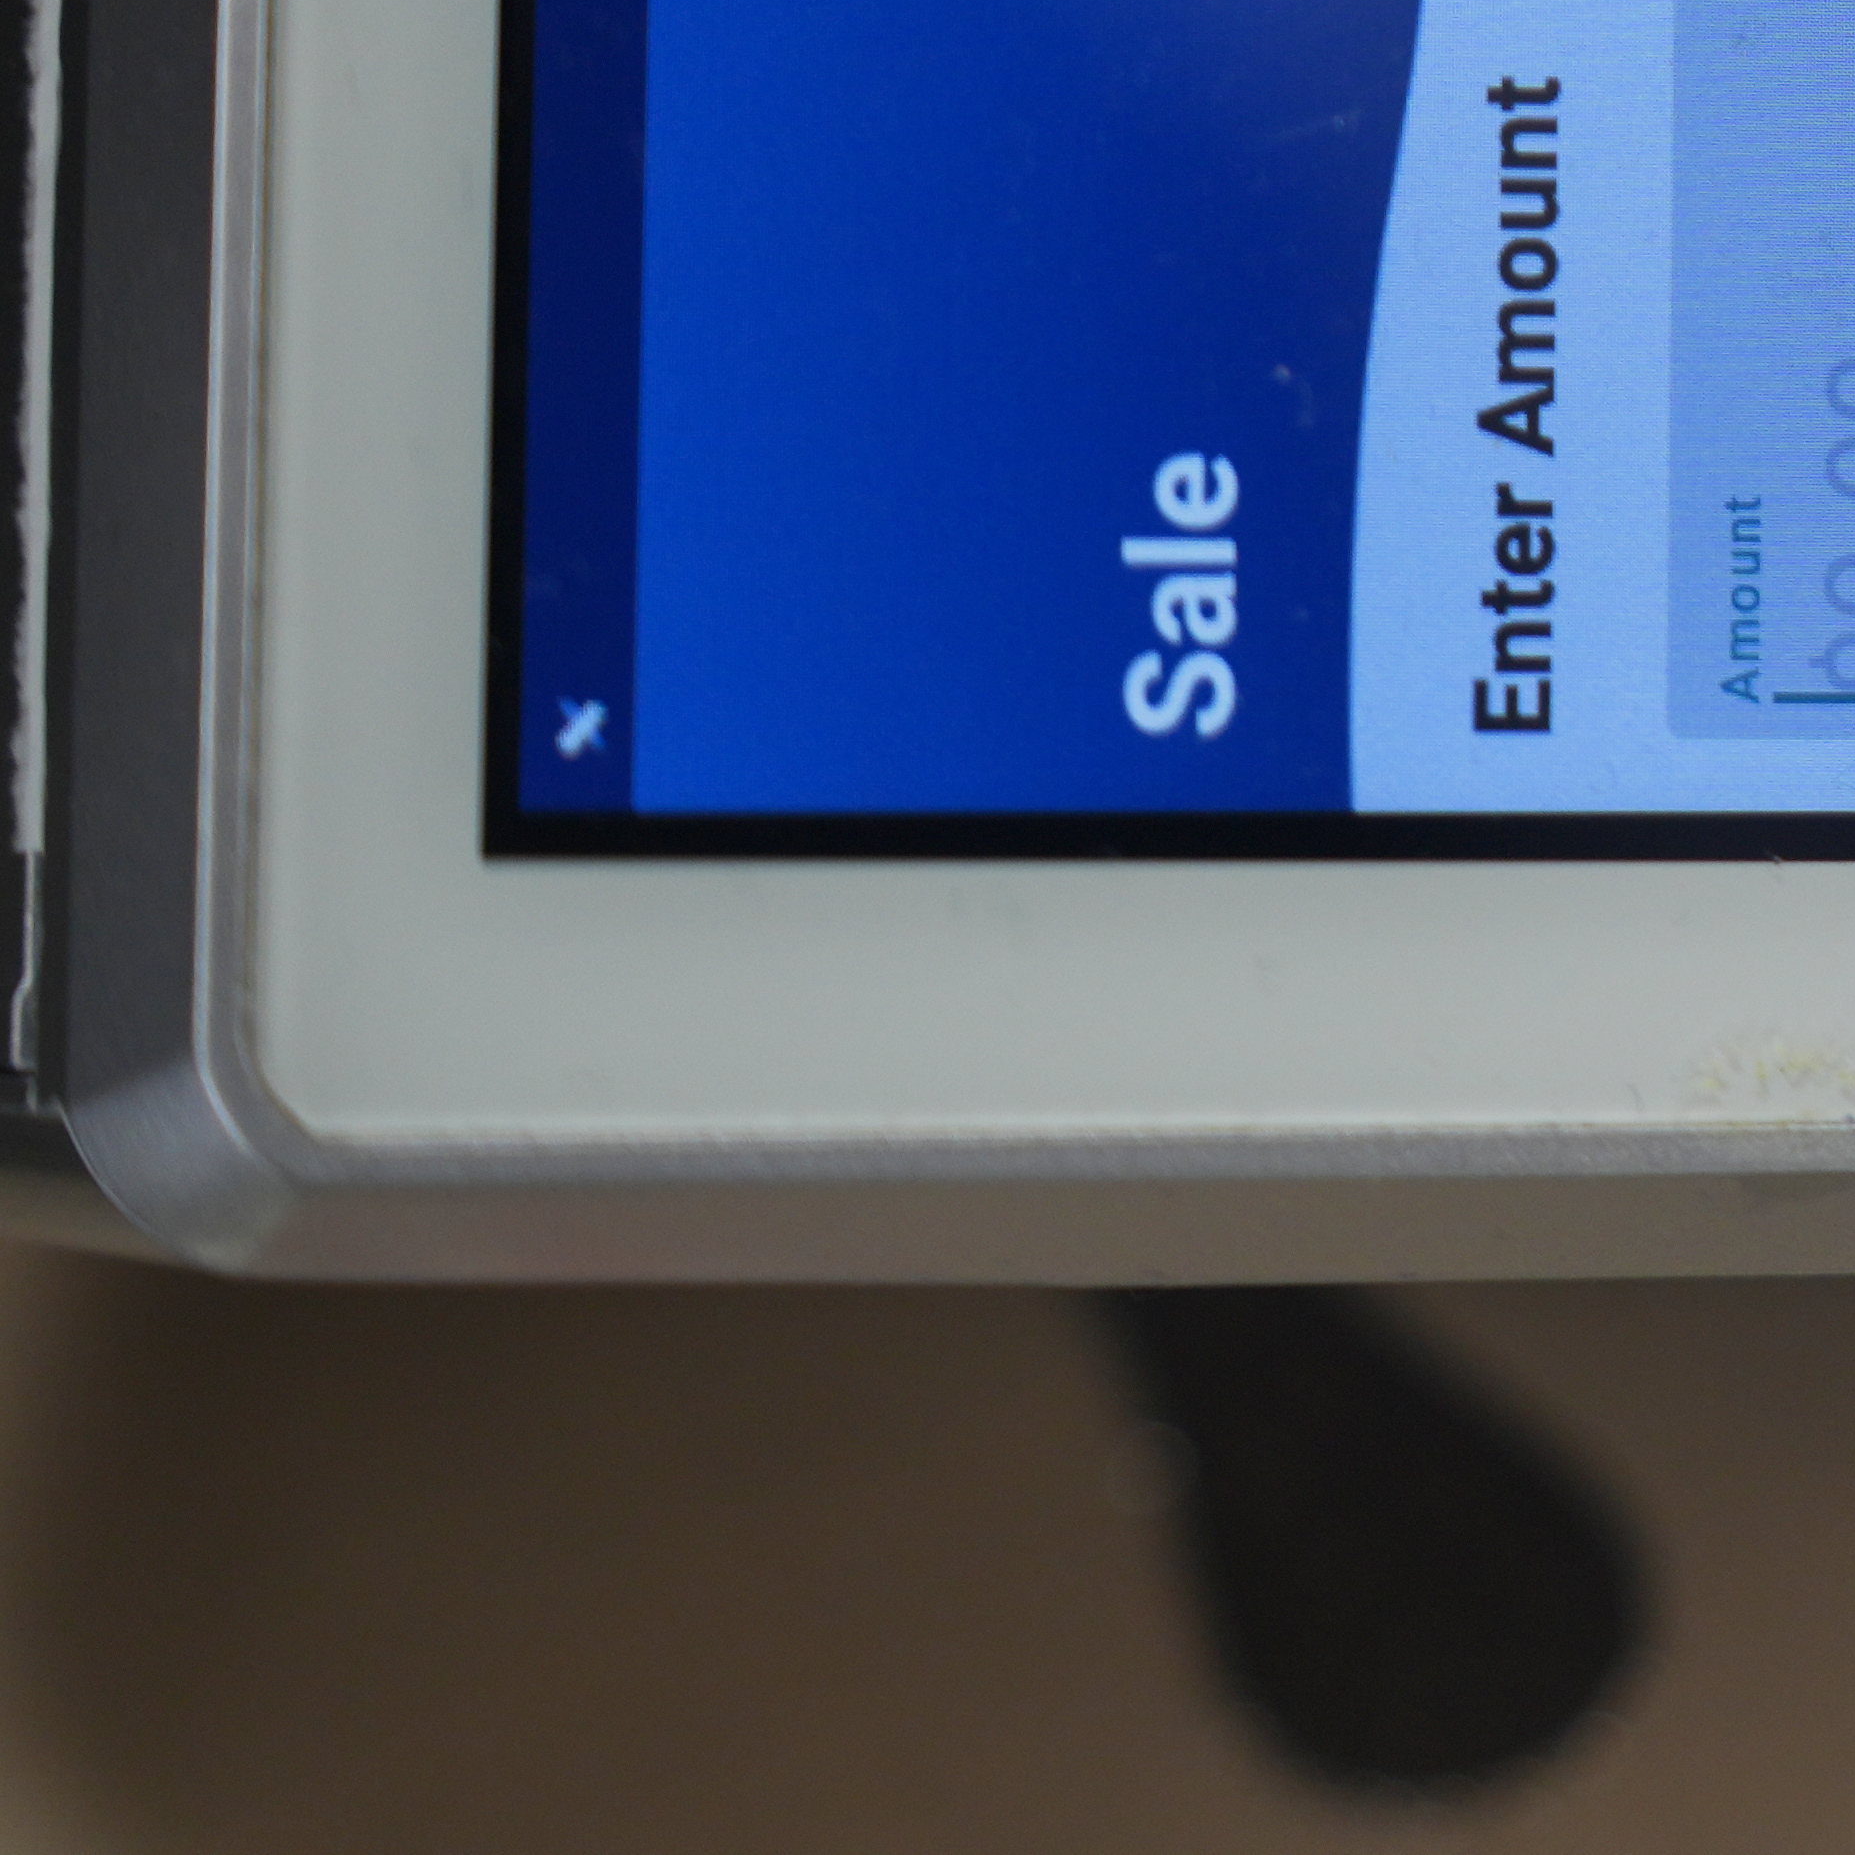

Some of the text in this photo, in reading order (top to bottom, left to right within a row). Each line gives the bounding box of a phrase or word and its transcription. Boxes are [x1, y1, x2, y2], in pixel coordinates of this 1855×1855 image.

[1473, 75, 1562, 735] Enter Amount
[1121, 450, 1240, 737] Sale
[1722, 492, 1764, 706] Amount
